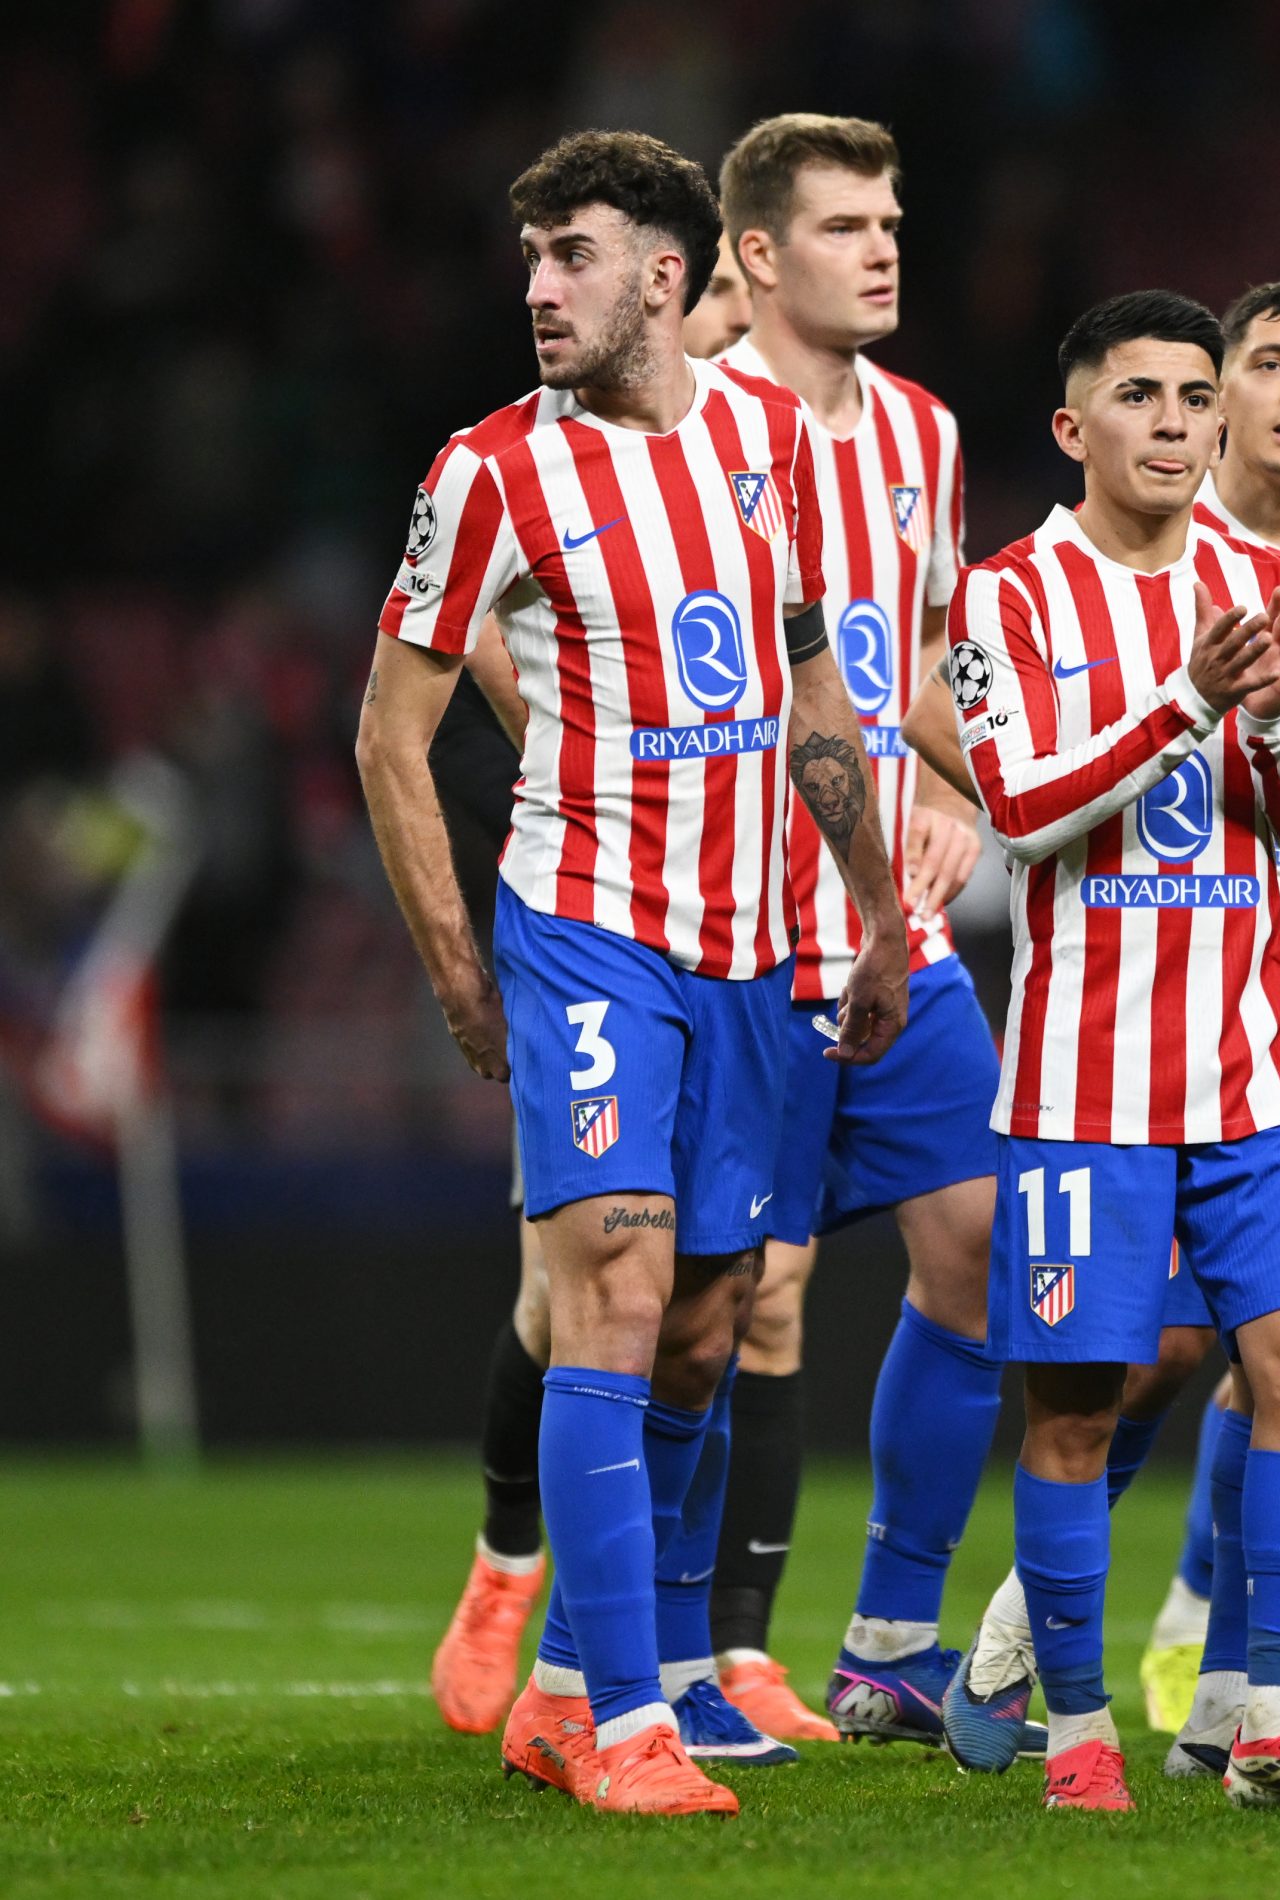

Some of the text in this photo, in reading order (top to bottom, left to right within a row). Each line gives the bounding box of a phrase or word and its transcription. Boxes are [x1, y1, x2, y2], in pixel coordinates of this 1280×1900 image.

[639, 719, 777, 757] RIYADH AIR
[1089, 878, 1254, 904] RIYADH AIR
[566, 1001, 616, 1090] 3
[1018, 1167, 1090, 1256] 11
